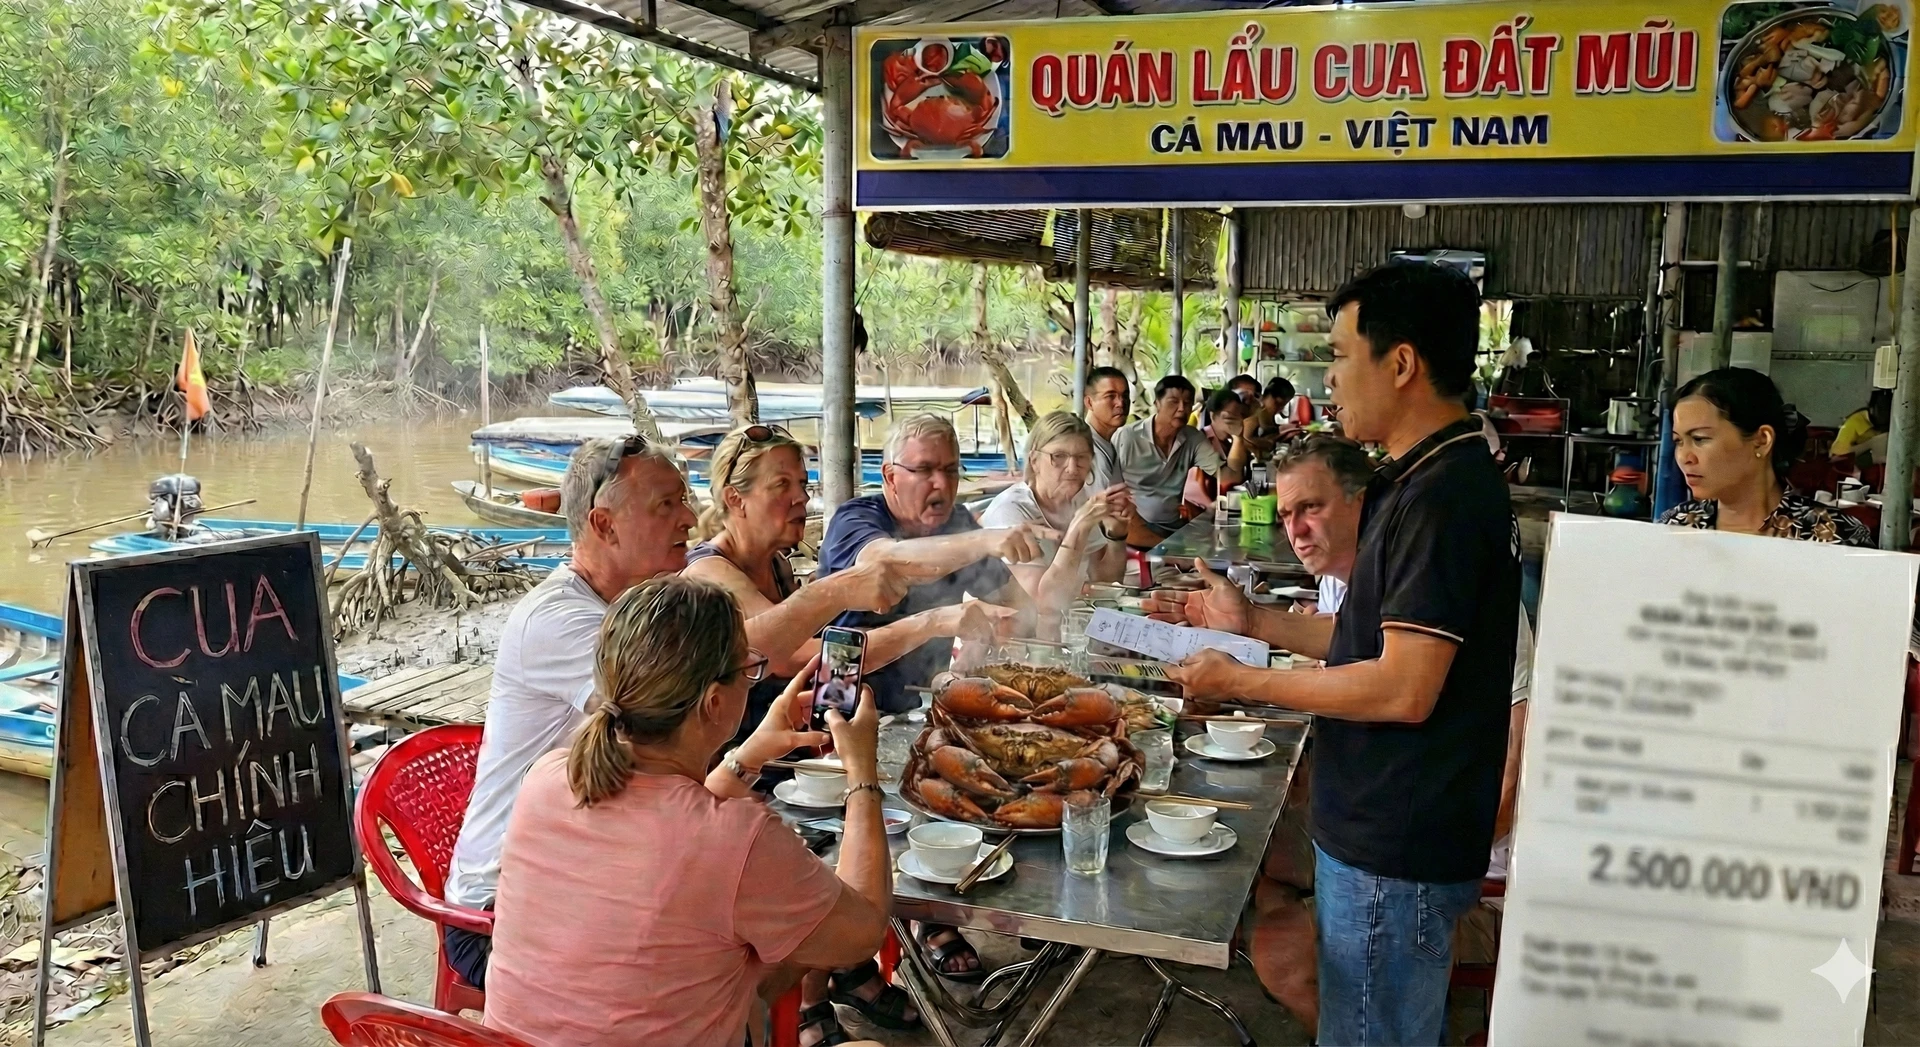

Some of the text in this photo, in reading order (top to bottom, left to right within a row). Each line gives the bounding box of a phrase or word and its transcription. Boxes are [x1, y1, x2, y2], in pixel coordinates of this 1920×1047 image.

[1031, 15, 1697, 114] QUÁN LẨU CUA ĐẤT MŨI
[1217, 120, 1303, 152] MAU
[1346, 111, 1437, 155] VIỆT
[1453, 114, 1549, 146] NAM
[129, 573, 299, 669] CUA
[120, 664, 327, 768] CÀ MAU
[147, 740, 322, 845] CHÍNH
[182, 818, 317, 917] HIỆU
[1588, 842, 1862, 912] 2.500.000 VND
